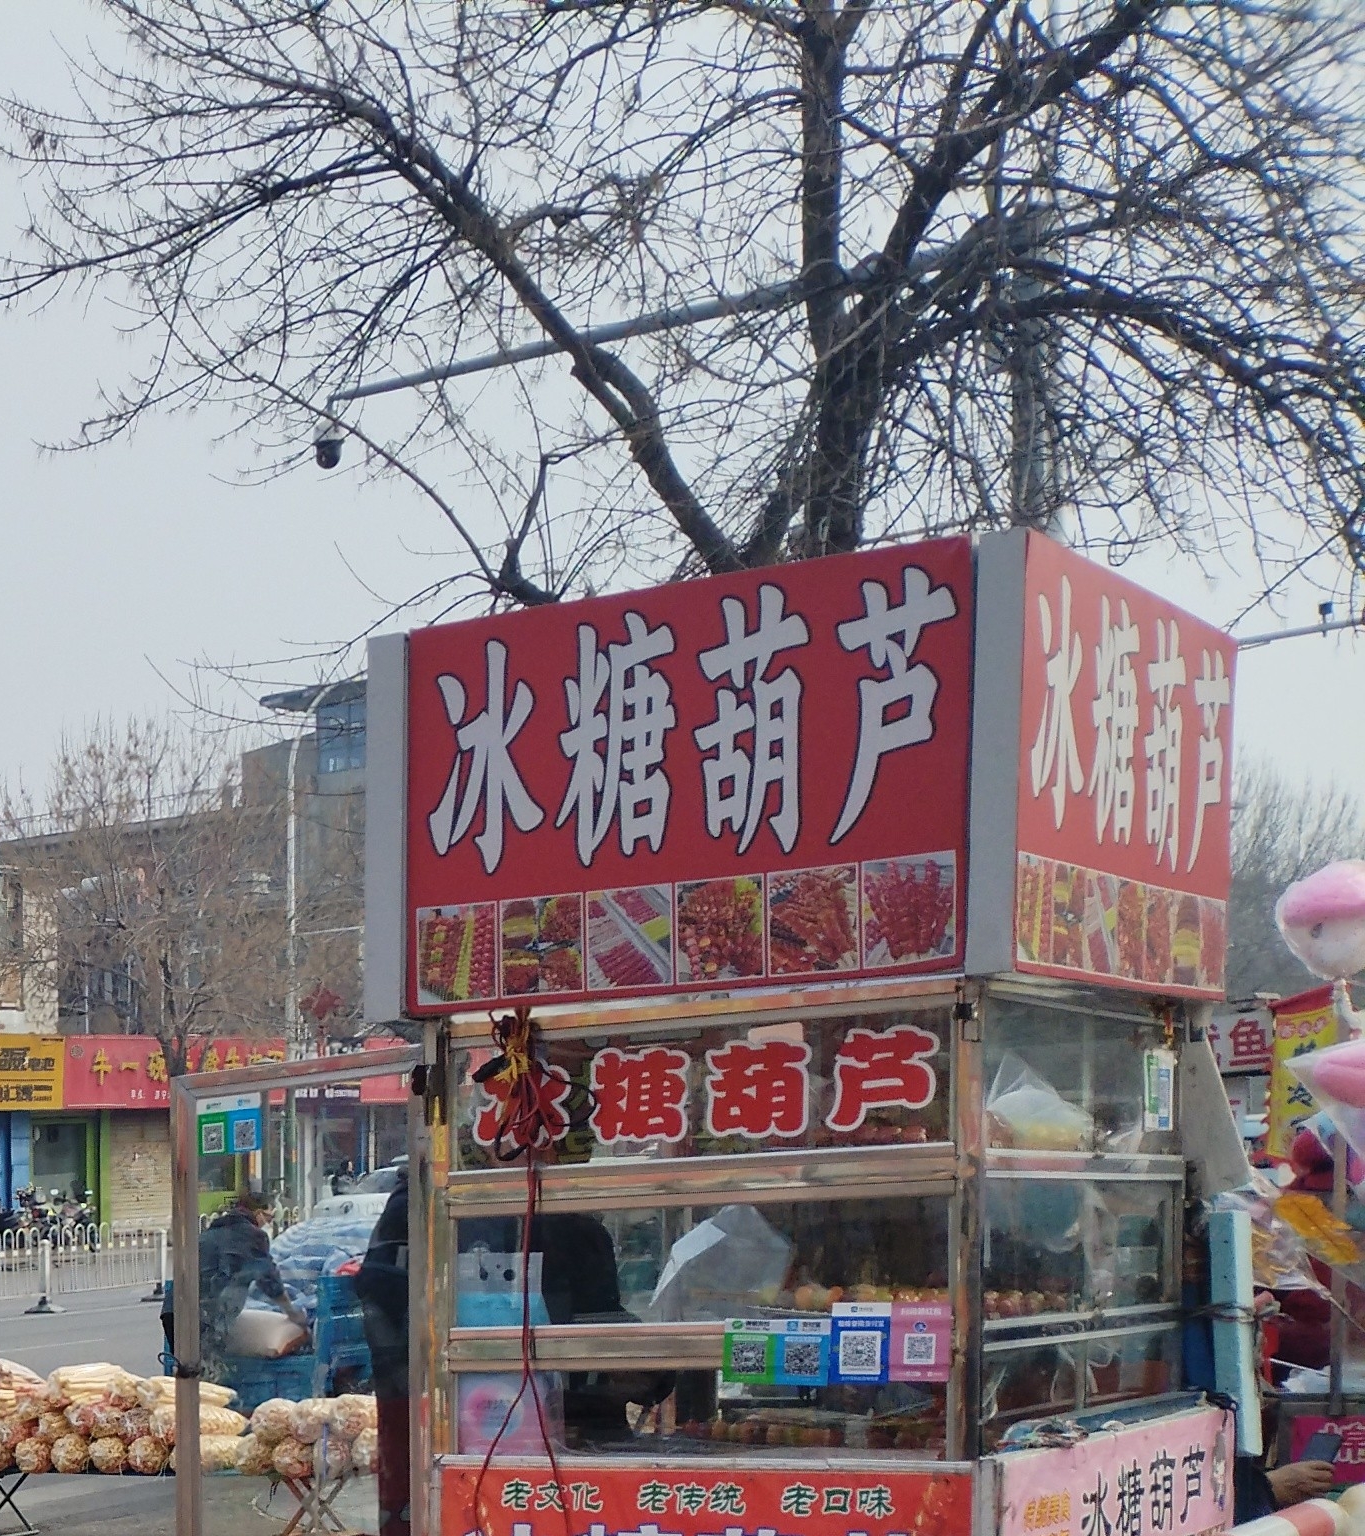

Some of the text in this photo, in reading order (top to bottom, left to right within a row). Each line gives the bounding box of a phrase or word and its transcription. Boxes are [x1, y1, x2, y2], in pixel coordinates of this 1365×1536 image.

[429, 565, 958, 874] 冰糖葫芦
[1030, 574, 1231, 875] 冰糖葫芦
[503, 1480, 895, 1517] 老文化 老传统 老口味
